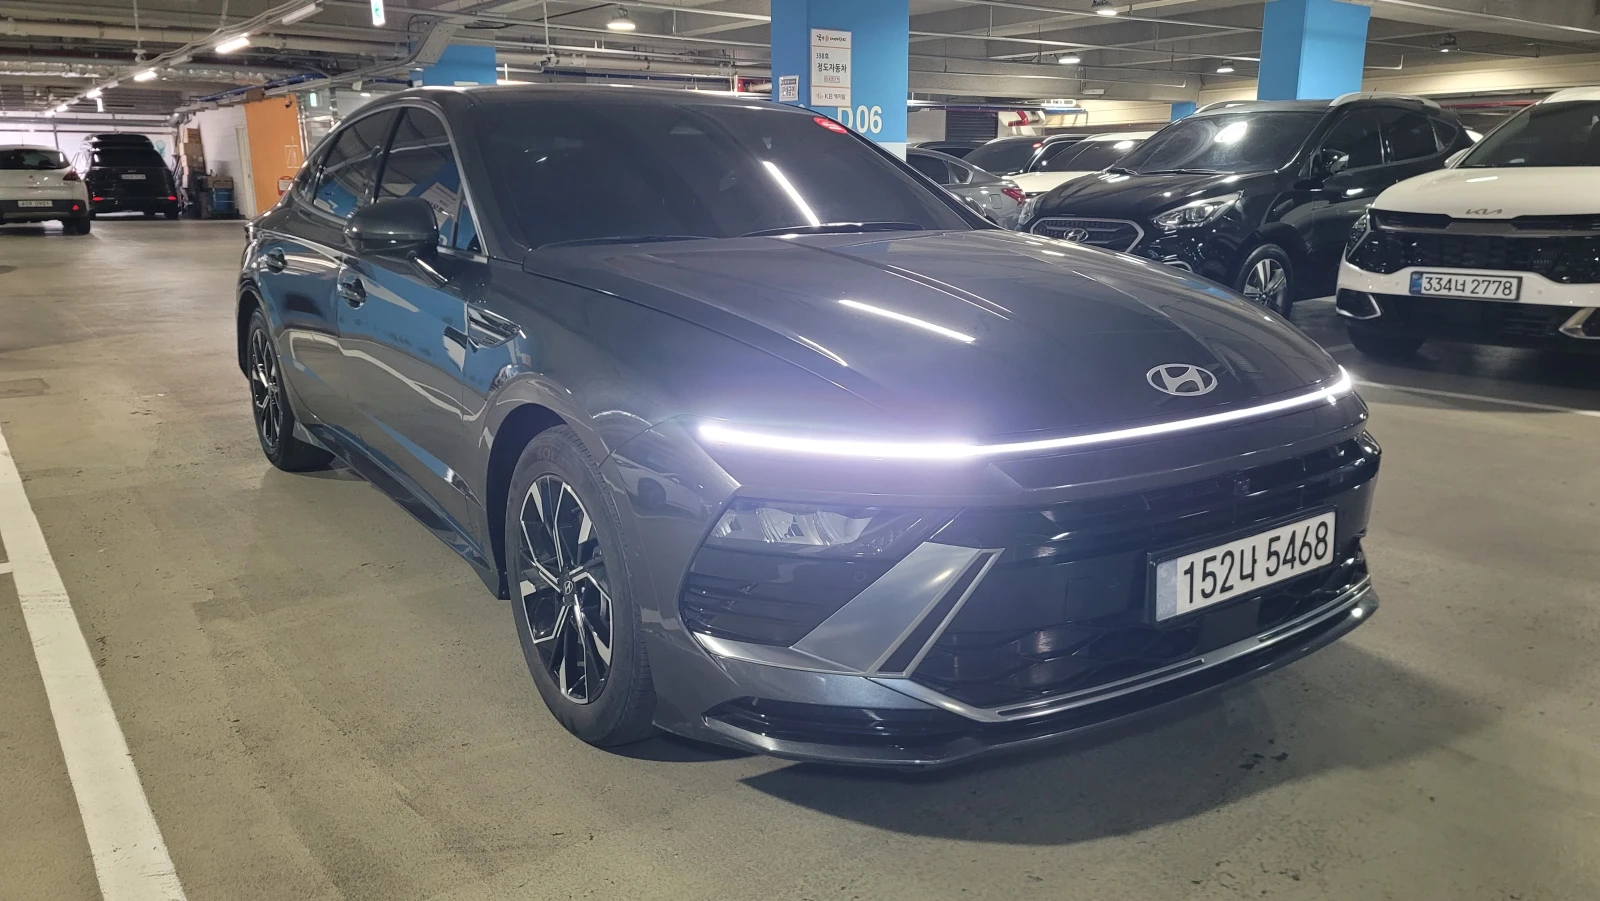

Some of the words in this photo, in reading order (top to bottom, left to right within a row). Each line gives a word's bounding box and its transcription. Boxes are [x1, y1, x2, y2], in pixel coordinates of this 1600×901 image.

[1423, 276, 1466, 293] 334너
[1470, 278, 1513, 296] 2778
[1183, 545, 1258, 604] 152나
[1265, 520, 1329, 577] 5468
